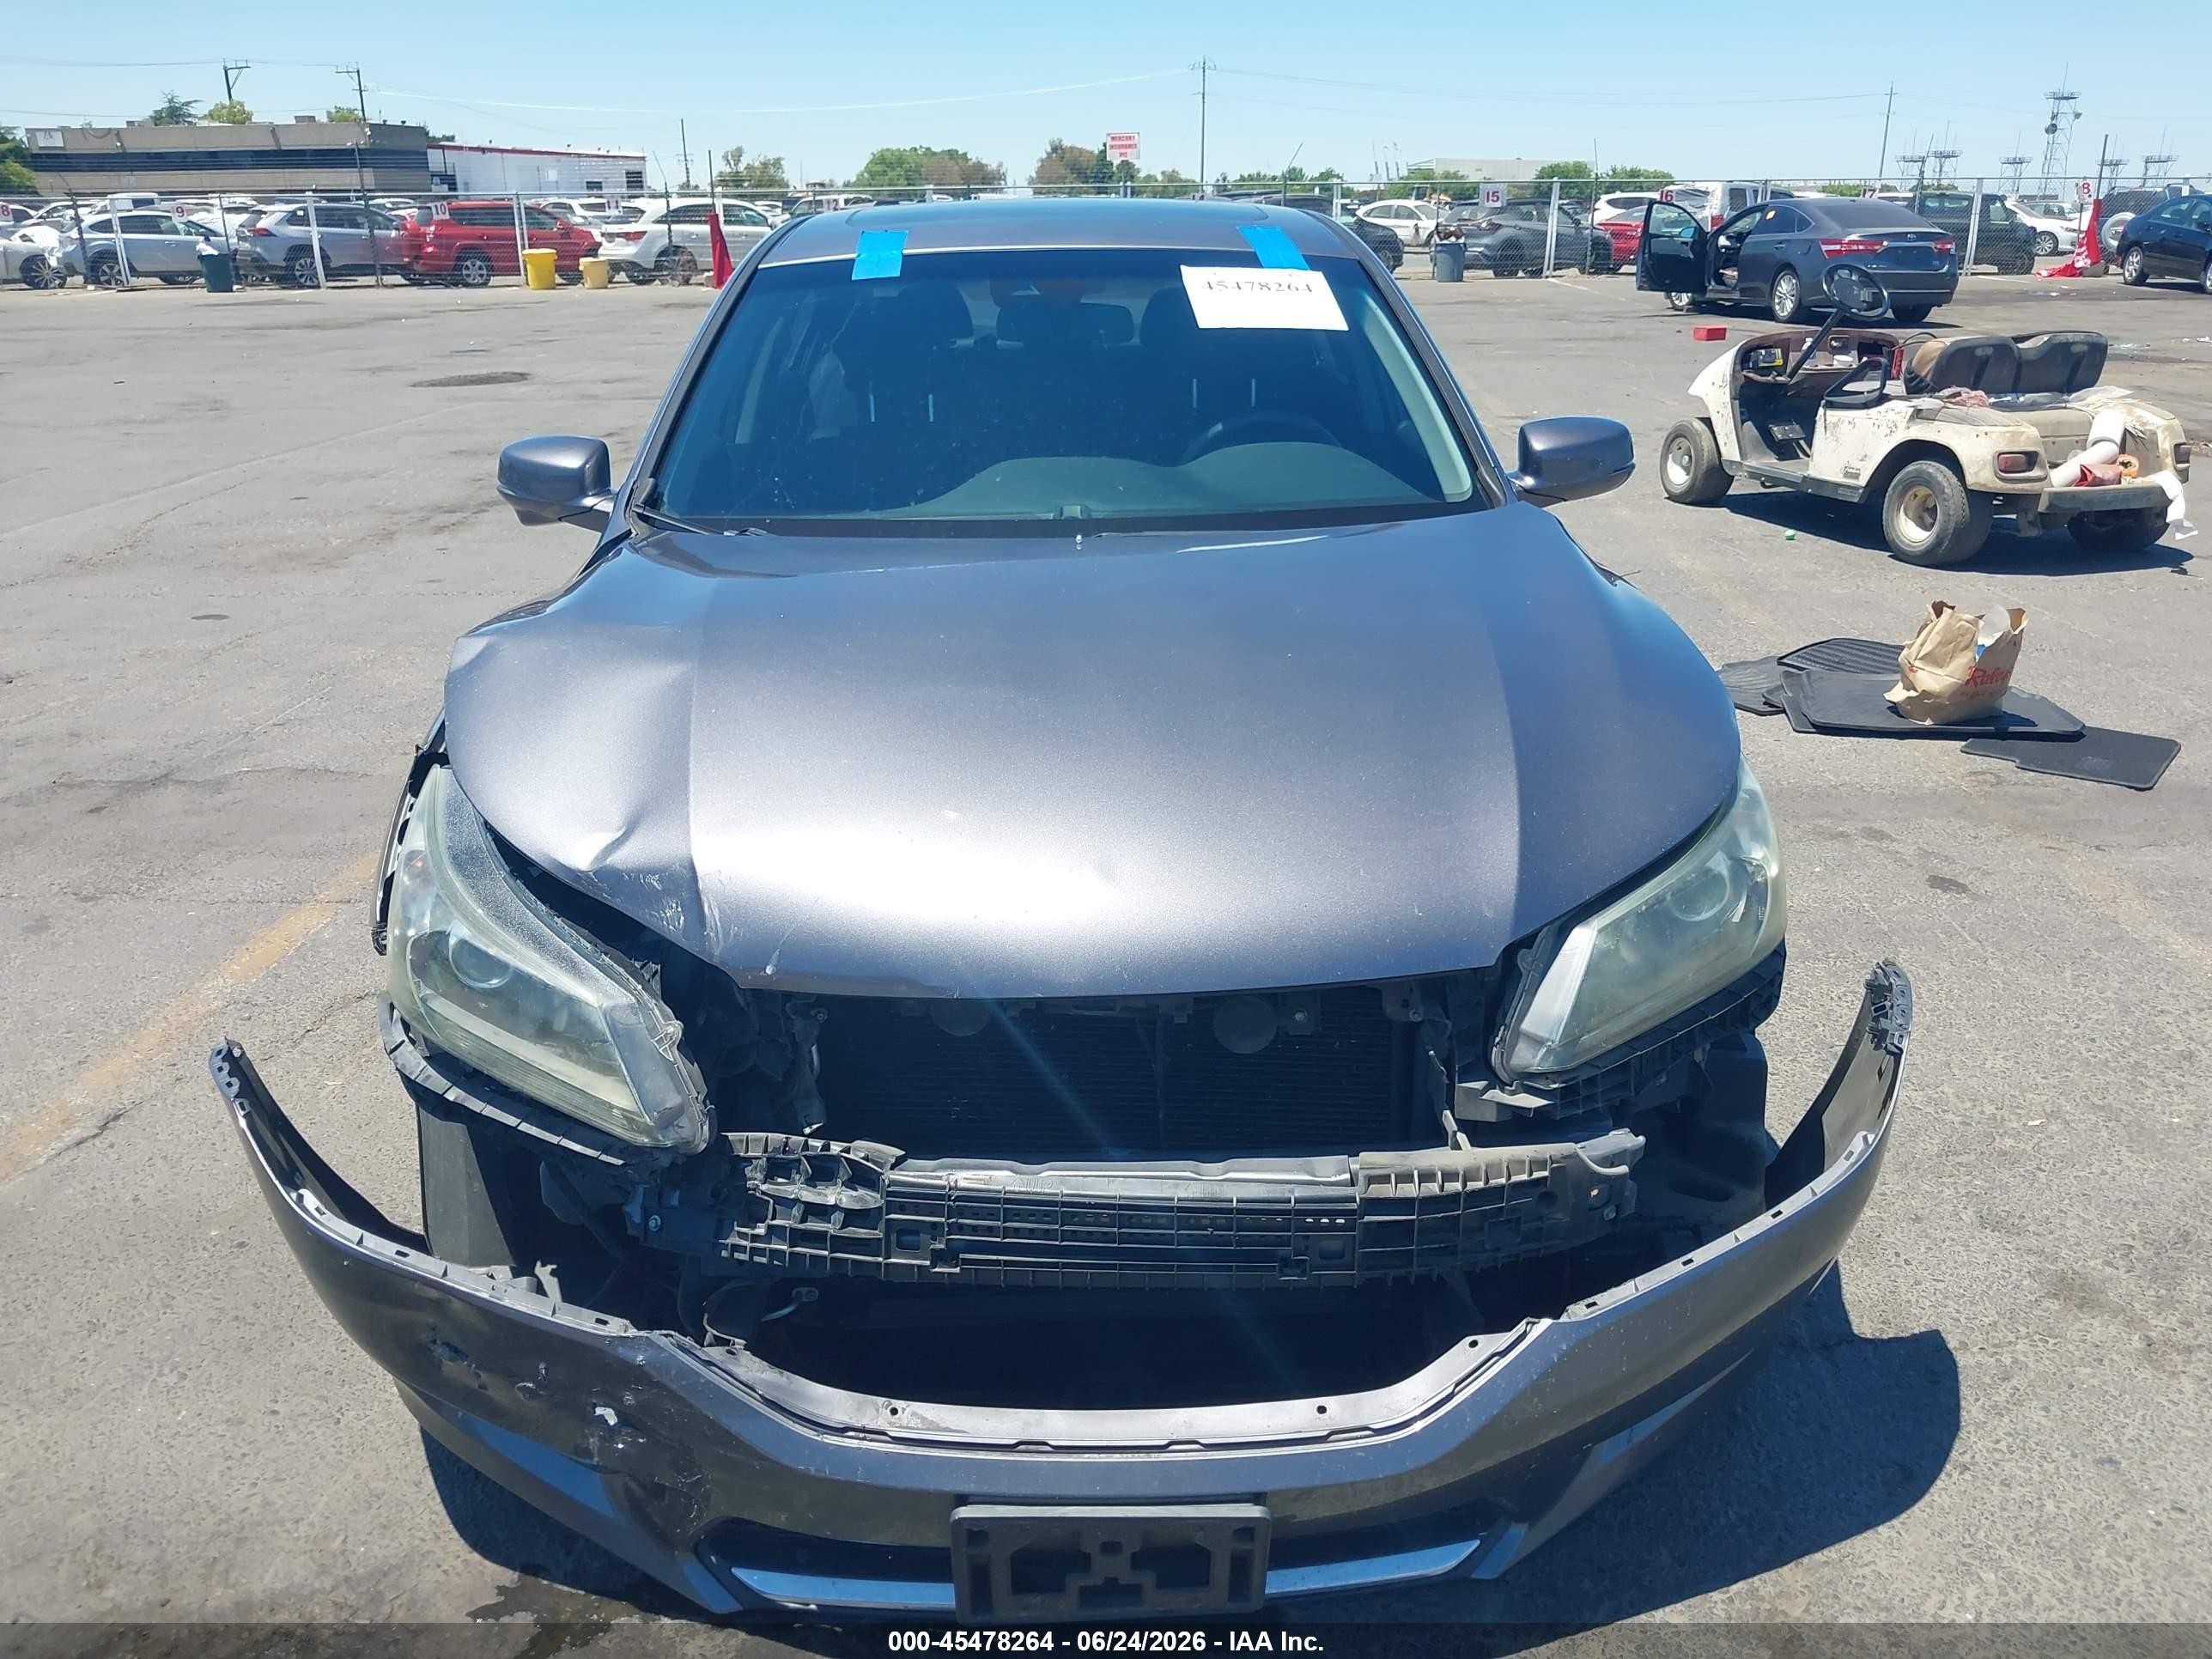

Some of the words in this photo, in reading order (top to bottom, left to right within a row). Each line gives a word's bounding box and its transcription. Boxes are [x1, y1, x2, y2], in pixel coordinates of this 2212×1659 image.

[1486, 191, 1499, 203] 15
[1660, 190, 1674, 202] 16
[1862, 188, 1877, 198] 17
[1, 205, 10, 216] 8
[434, 203, 447, 216] 10
[827, 198, 839, 211] 12
[176, 206, 185, 217] 9
